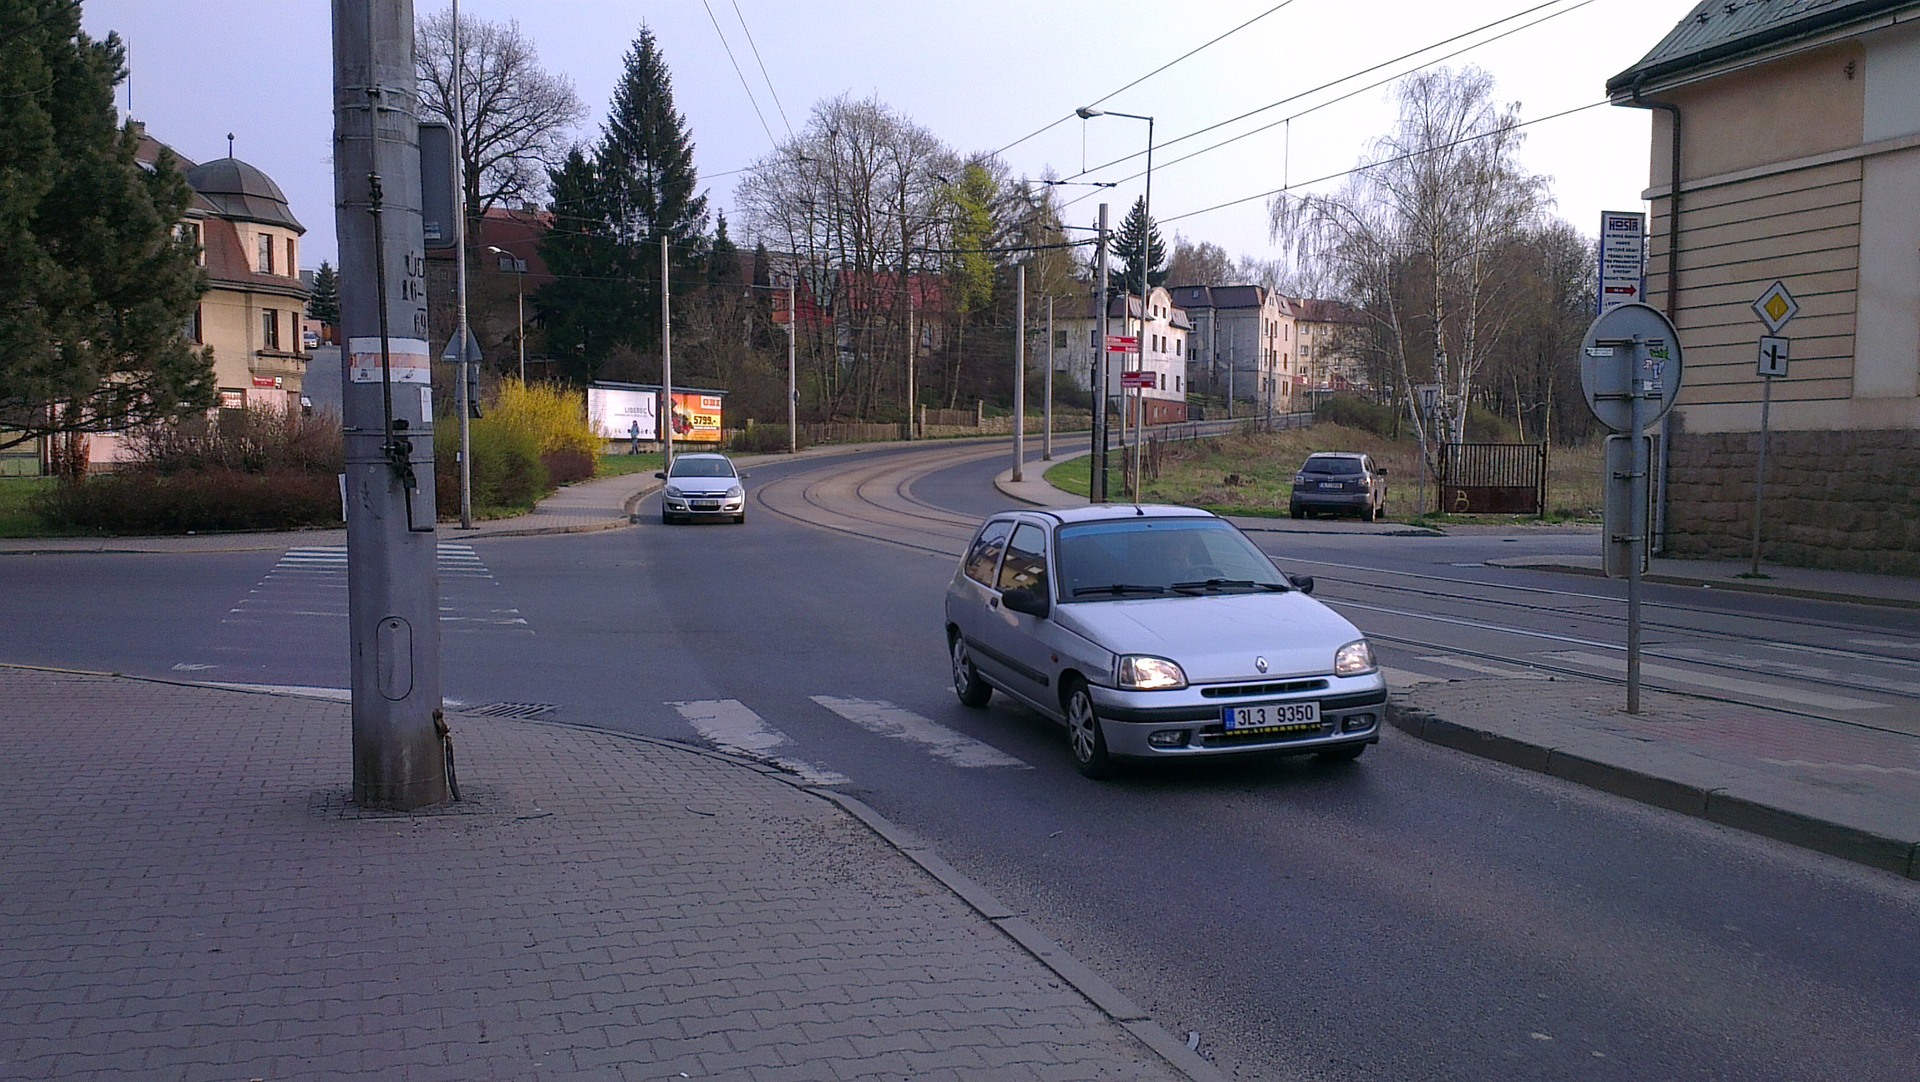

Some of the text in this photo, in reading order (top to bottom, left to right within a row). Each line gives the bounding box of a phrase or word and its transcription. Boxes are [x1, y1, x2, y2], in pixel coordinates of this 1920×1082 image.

[703, 398, 720, 406] OBI
[1454, 490, 1470, 512] B
[1238, 708, 1266, 726] 3L3
[1277, 704, 1314, 723] 9350
